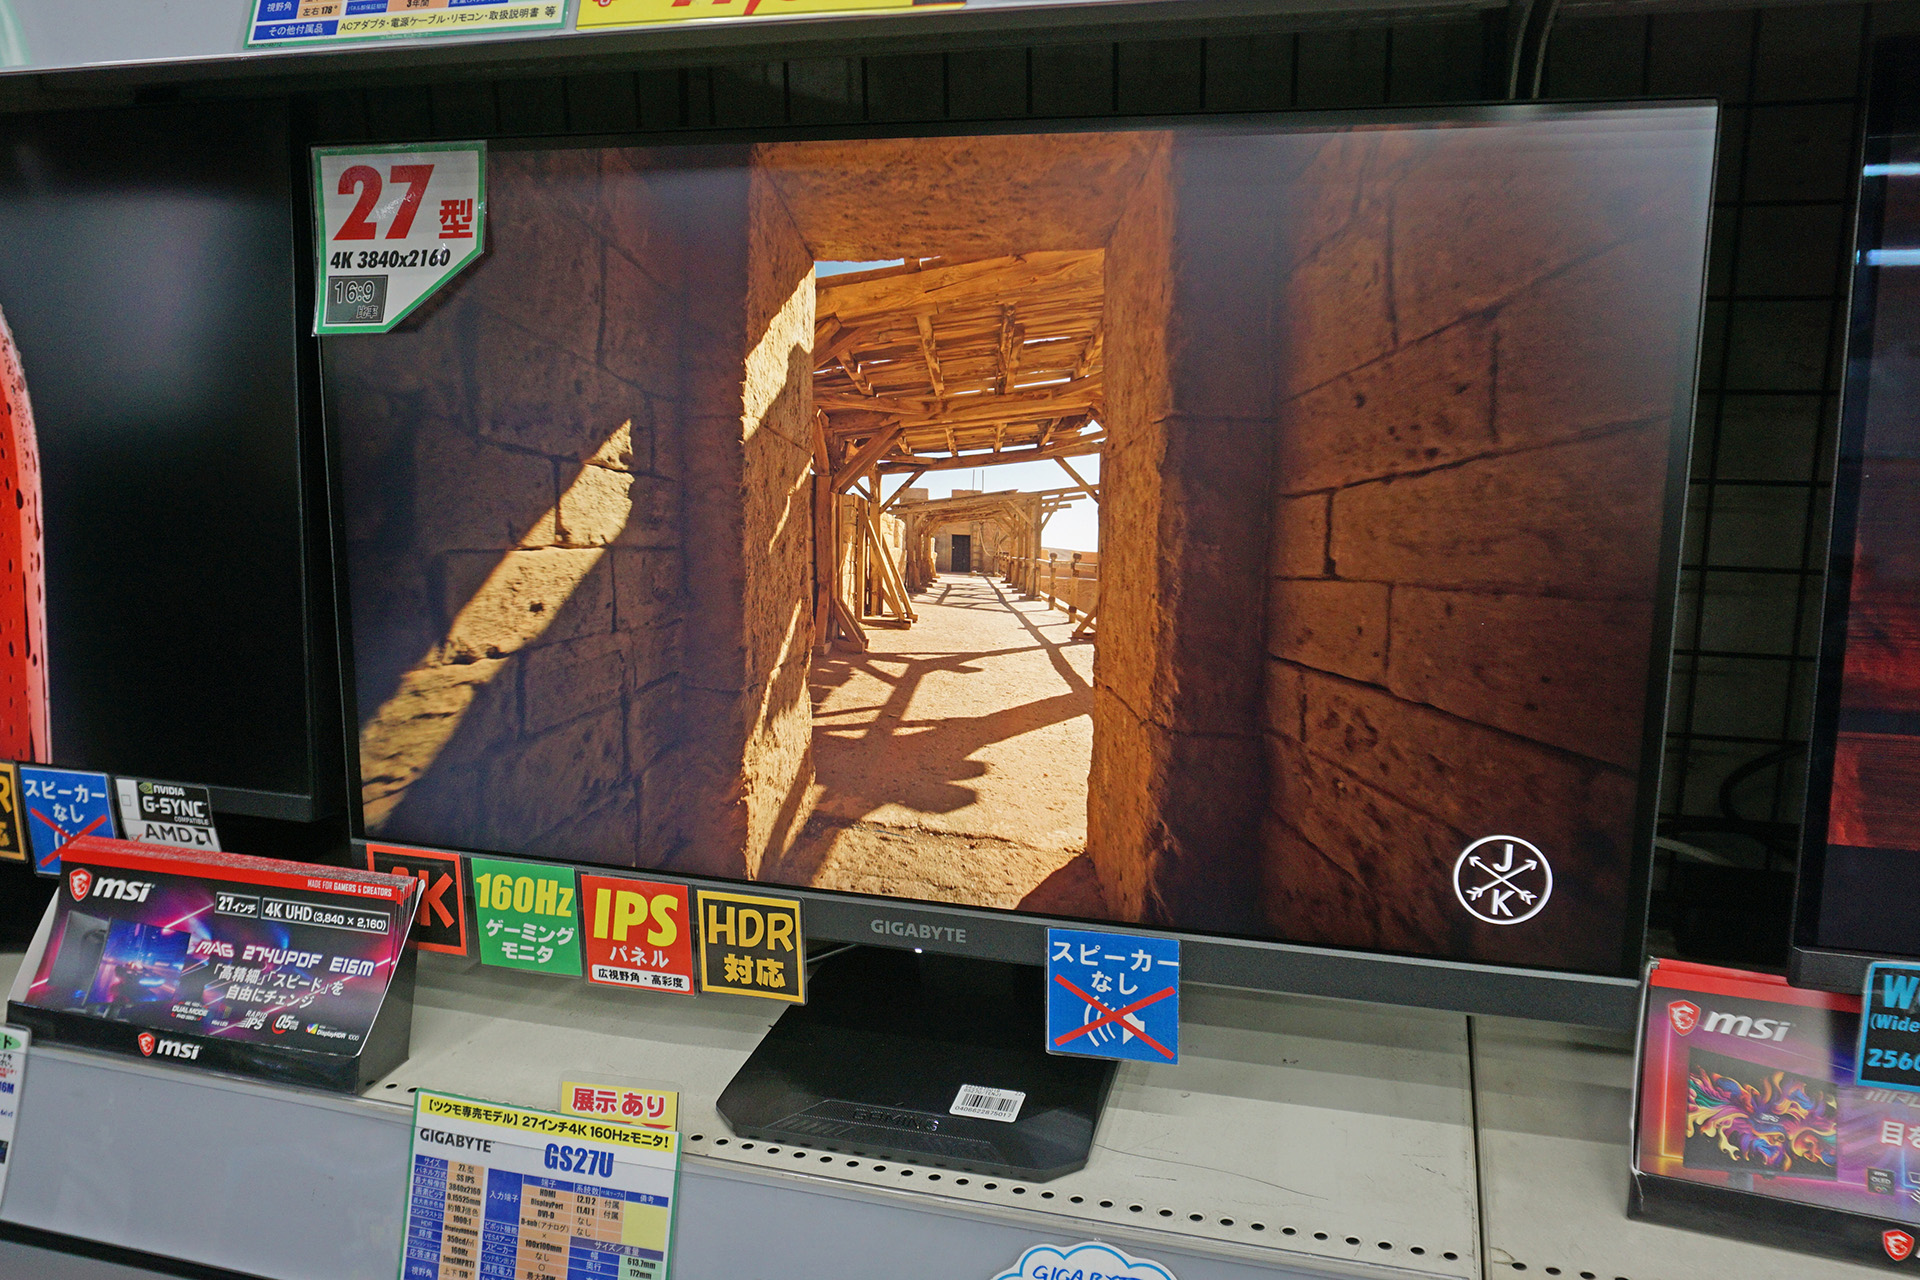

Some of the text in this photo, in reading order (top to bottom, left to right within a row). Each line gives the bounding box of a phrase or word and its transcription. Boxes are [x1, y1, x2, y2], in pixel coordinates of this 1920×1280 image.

[266, 2, 292, 12] 視野角
[302, 7, 319, 17] 左右
[268, 23, 324, 37] その他付属品
[330, 250, 451, 269] 4K 3840x2160
[334, 280, 375, 304] 16:9
[356, 305, 379, 319] 比率
[24, 780, 106, 804] スピーカー
[152, 784, 186, 796] NVIDIA
[52, 803, 85, 824] なし
[142, 796, 206, 818] G-SYNC
[174, 816, 210, 826] COMPATIBLE
[146, 826, 193, 843] AMD
[1492, 844, 1514, 872] J
[93, 876, 151, 903] msi
[307, 879, 392, 897] MADE FOR GAMERS & CREATORS
[391, 866, 455, 928] K
[476, 873, 573, 918] 160Hz
[1492, 888, 1516, 917] K
[218, 896, 256, 914] 27インチ
[265, 902, 282, 918] 4K
[285, 904, 313, 922] UHD
[313, 912, 344, 925] (3,840
[357, 918, 386, 931] 2,160)
[594, 888, 679, 949] IPS
[486, 919, 574, 950] ゲーミング
[708, 905, 795, 954] HDR
[870, 920, 967, 944] GIGABYTE
[196, 939, 376, 976] MAG 274UPDF E16M
[500, 940, 555, 964] モニタ
[609, 944, 670, 969] パネル
[1052, 941, 1180, 973] スピーカー
[598, 968, 684, 989] 広視野角・高彩度
[724, 954, 786, 989] 対応
[213, 962, 344, 996] 「高精細」「スピード」を
[1091, 971, 1139, 995] なし
[226, 985, 315, 1009] 自由にチェンジ
[246, 1010, 268, 1020] RAPID
[245, 1018, 265, 1030] IPS
[1704, 1011, 1791, 1042] msi
[156, 1039, 201, 1061] msi
[429, 1099, 518, 1128] 【ツクモ専売モデル】
[522, 1116, 587, 1137] 27インチ4K
[418, 1128, 492, 1153] GIGABYTE
[424, 1158, 441, 1167] サイズ
[544, 1143, 615, 1178] GS27U
[416, 1167, 447, 1180] パネル方式
[456, 1174, 475, 1184] SS IPS
[449, 1183, 481, 1195] 3840x2160
[541, 1179, 557, 1188] 端子
[576, 1184, 600, 1197] 系統数
[415, 1186, 444, 1199] 画素ピッチ
[489, 1190, 519, 1203] 入力端子
[540, 1188, 557, 1198] HDMI
[531, 1198, 564, 1210] DisplayPort
[604, 1200, 620, 1210] 付属
[640, 1195, 655, 1205] 備考
[538, 1210, 555, 1219] DVI-D
[604, 1210, 619, 1220] 付属
[485, 1220, 518, 1235] ピボット機能
[578, 1217, 592, 1227] なし
[577, 1227, 591, 1237] なし
[484, 1234, 517, 1245] VESAアーム
[409, 1248, 438, 1261] 応答速度
[486, 1243, 514, 1255] スピーカー
[591, 1252, 599, 1260] 幅
[536, 1252, 550, 1262] なし
[627, 1258, 656, 1270] 613.7mm
[412, 1266, 433, 1278] 視野角
[483, 1264, 513, 1276] 消費電力
[586, 1261, 602, 1272] 奥行
[629, 1269, 652, 1280] 172mm
